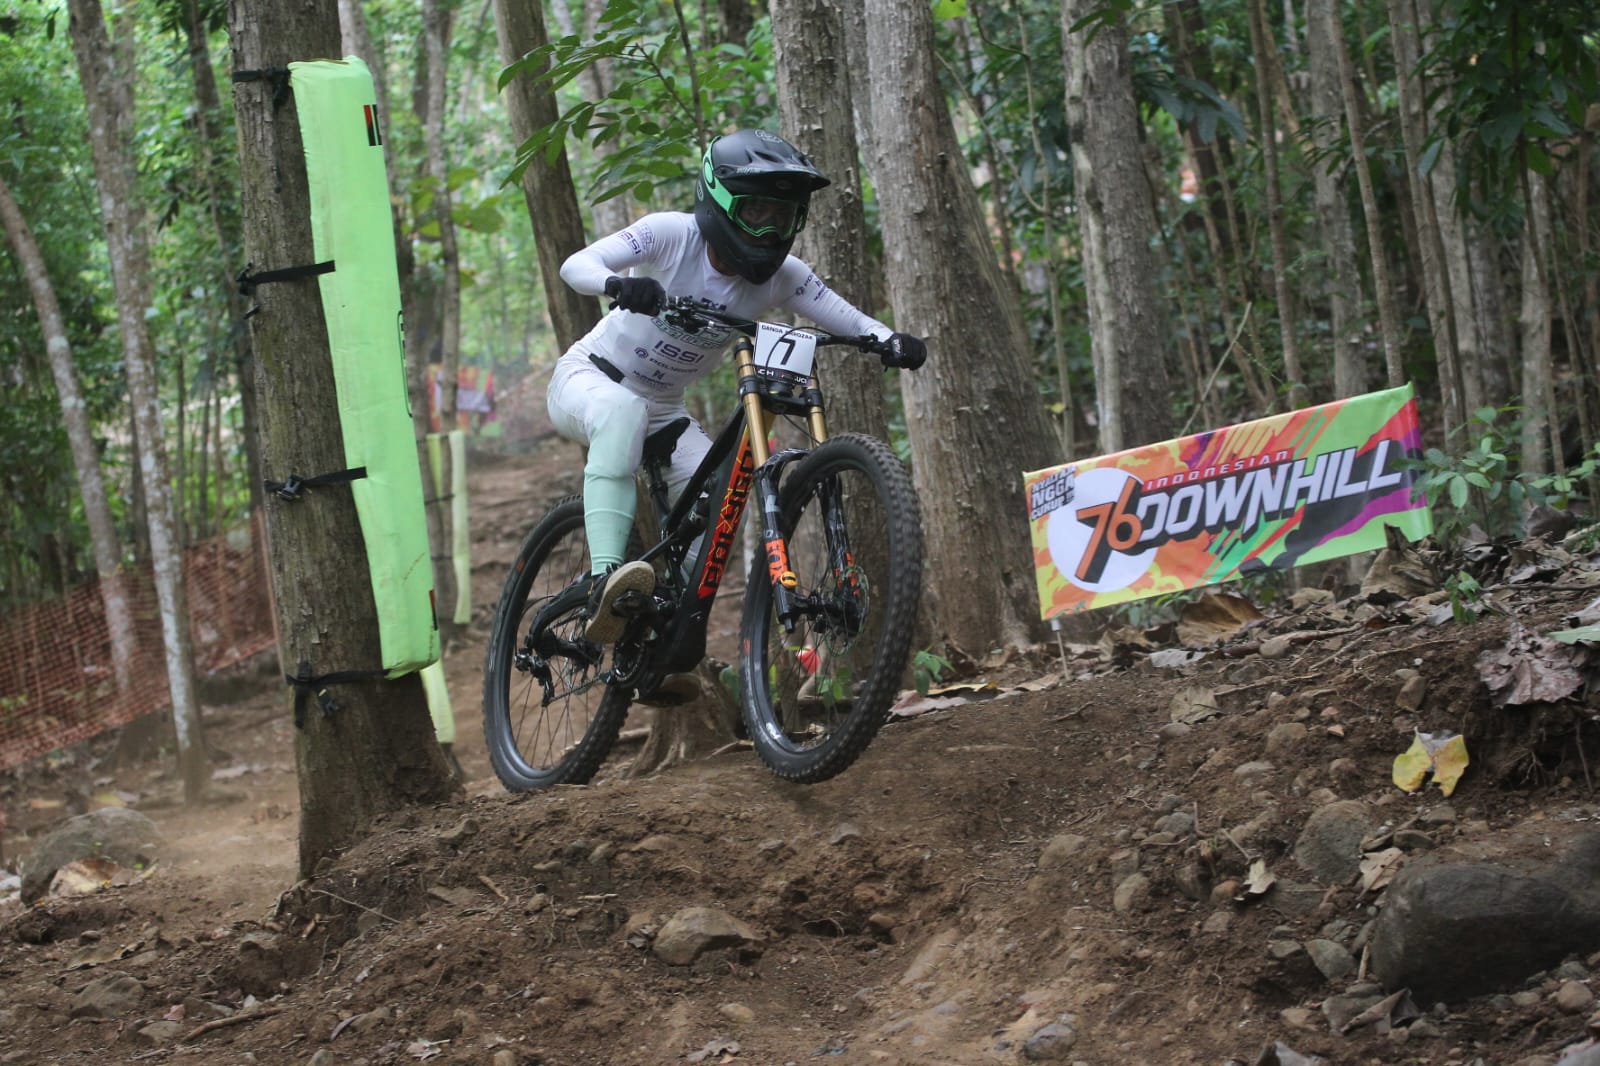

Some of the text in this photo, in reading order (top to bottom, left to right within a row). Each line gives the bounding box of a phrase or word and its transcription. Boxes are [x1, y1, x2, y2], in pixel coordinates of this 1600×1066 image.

[654, 340, 705, 364] ISSI
[779, 338, 796, 366] 7
[1136, 439, 1403, 540] DOWNHILL
[1146, 450, 1290, 491] INDONESIAN
[1031, 475, 1074, 510] NGGA
[705, 440, 753, 588] POLYGO
[1075, 476, 1144, 583] 76
